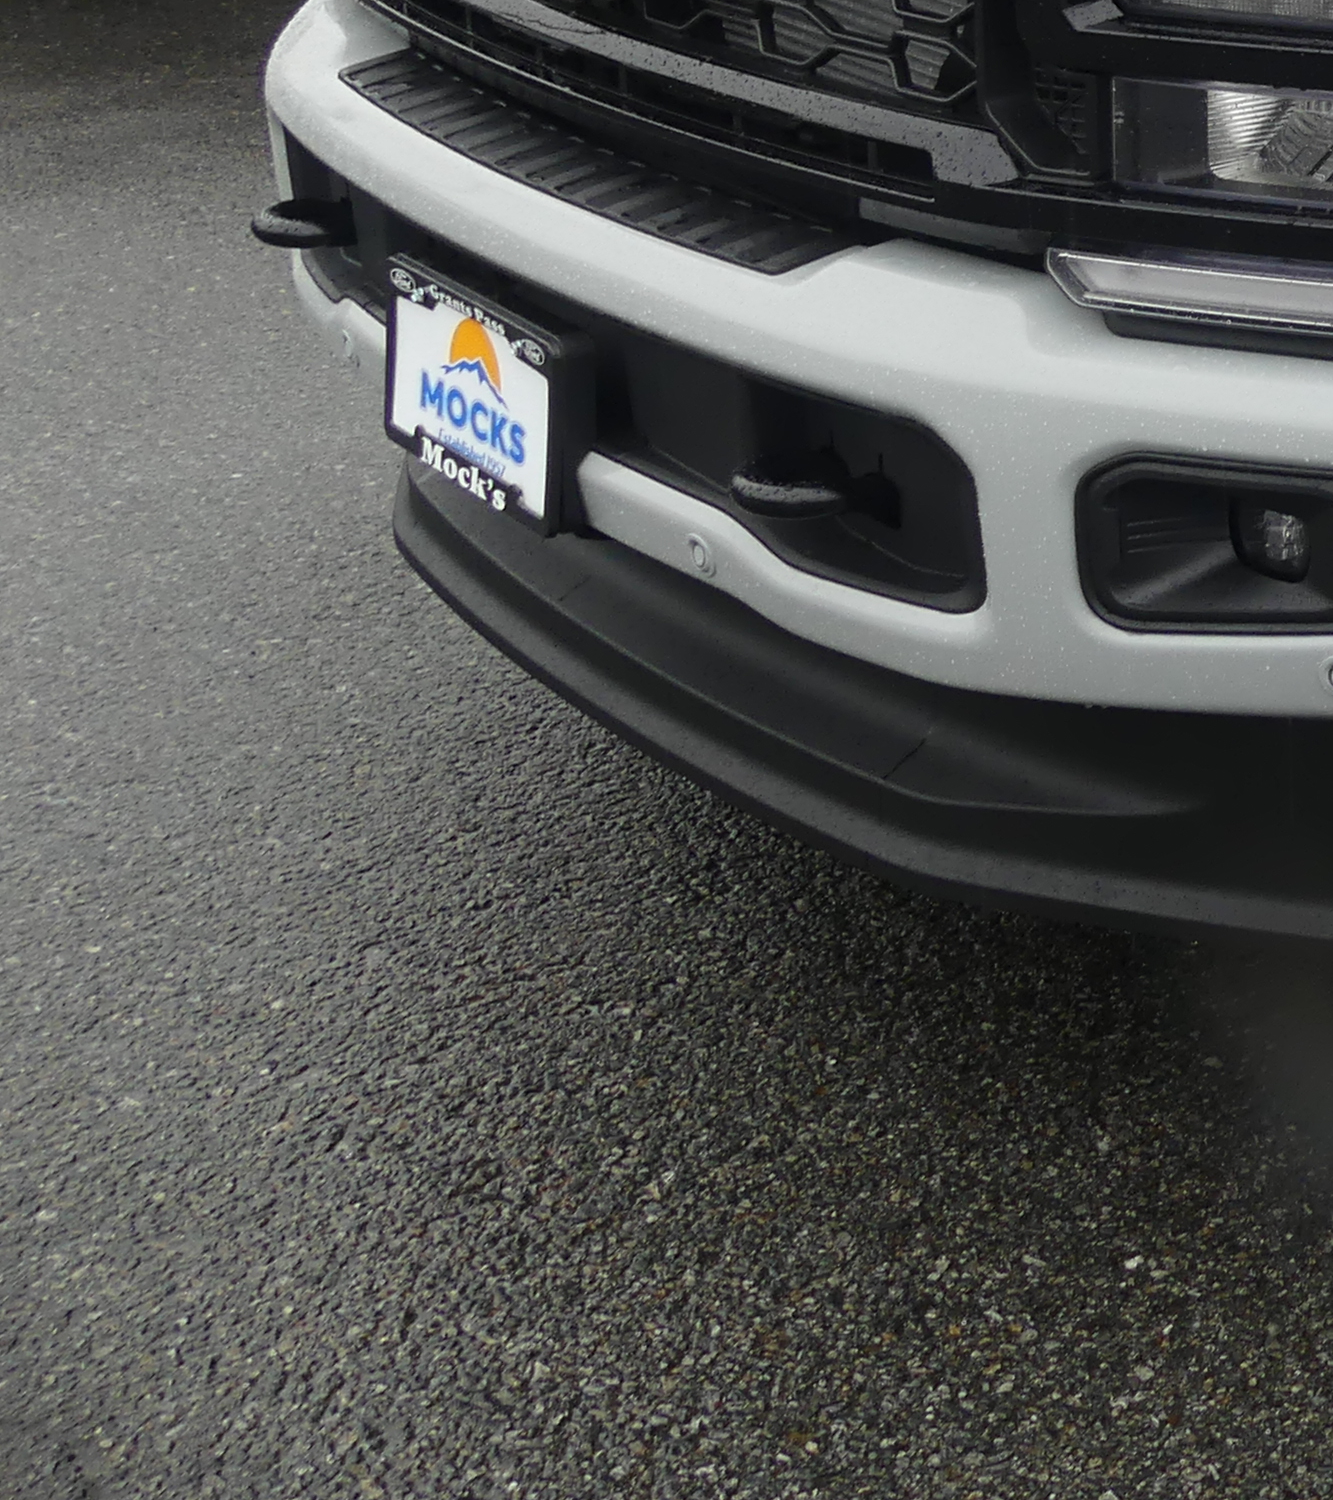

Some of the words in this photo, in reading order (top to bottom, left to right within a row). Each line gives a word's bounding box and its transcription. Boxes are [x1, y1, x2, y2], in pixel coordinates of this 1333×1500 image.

[429, 283, 473, 318] Grants
[473, 306, 506, 337] Pass
[420, 367, 528, 465] MOCKS
[420, 435, 507, 512] Mock's
